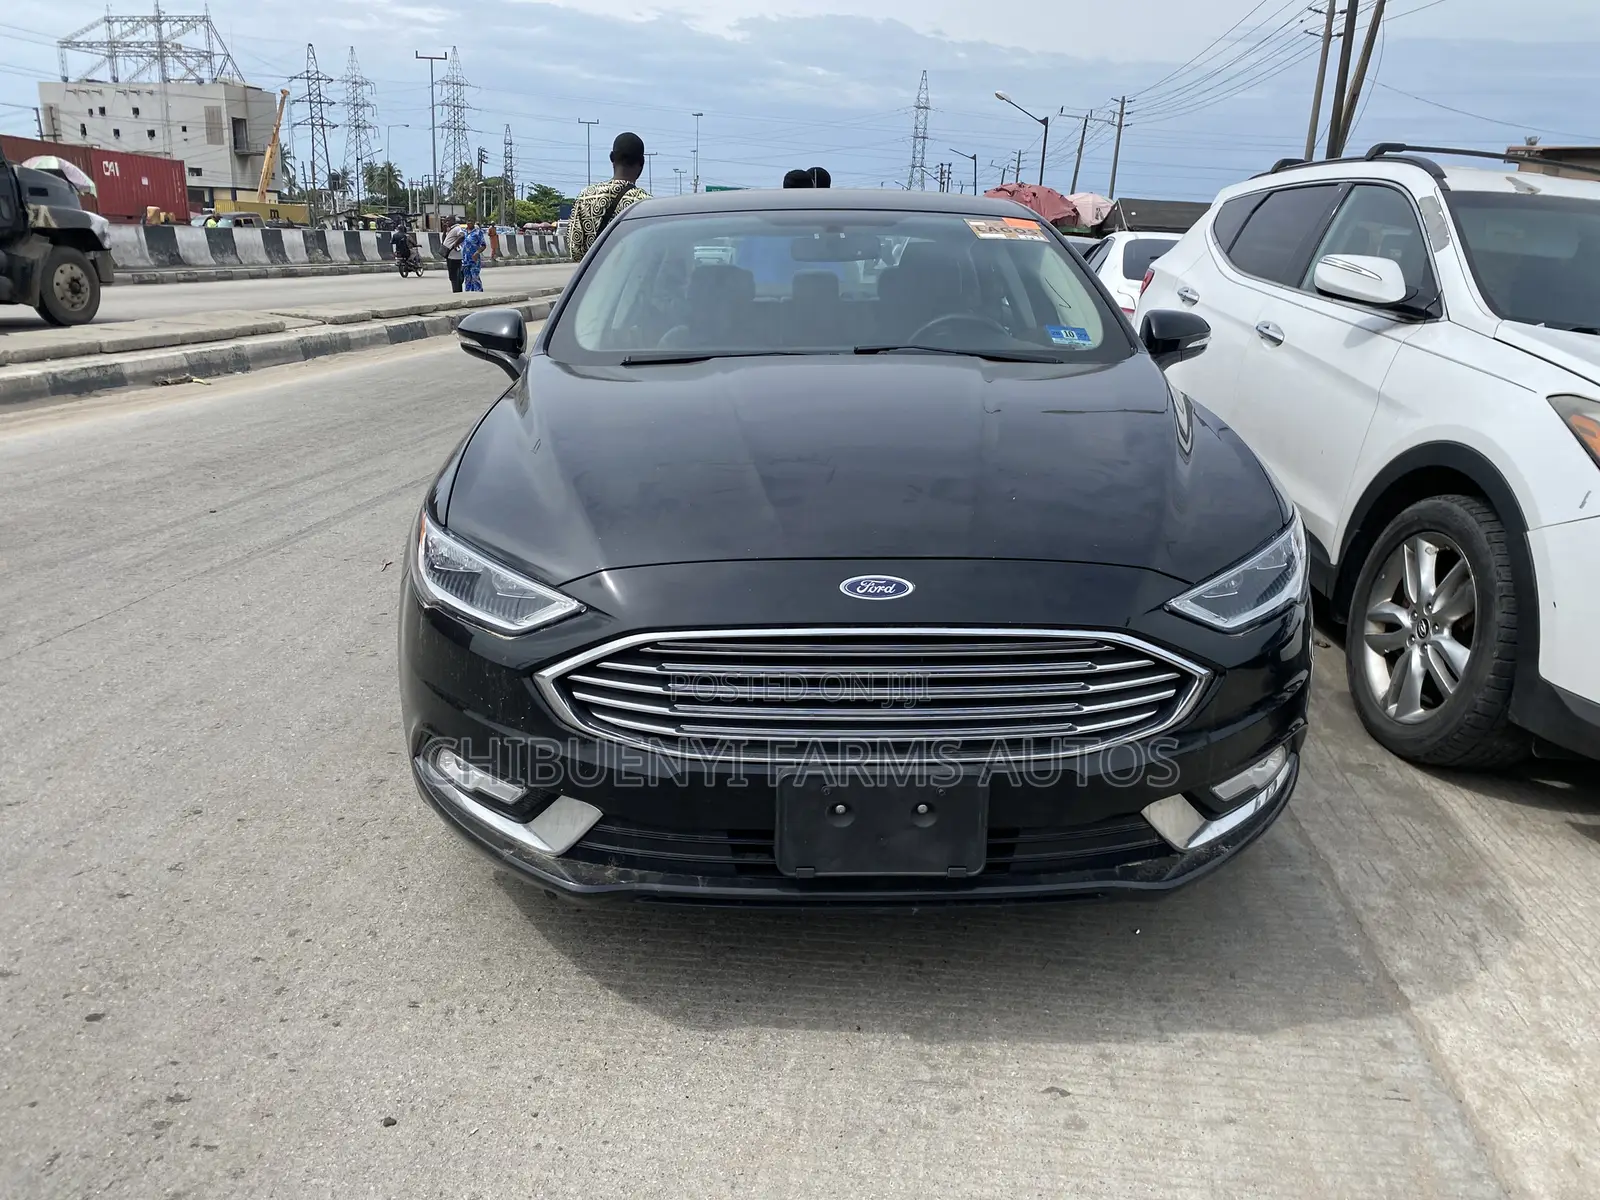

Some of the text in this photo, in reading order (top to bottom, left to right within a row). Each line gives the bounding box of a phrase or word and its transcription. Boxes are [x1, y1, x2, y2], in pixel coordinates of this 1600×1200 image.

[102, 160, 119, 176] CAI
[1063, 330, 1075, 338] 10
[856, 579, 896, 594] Ford
